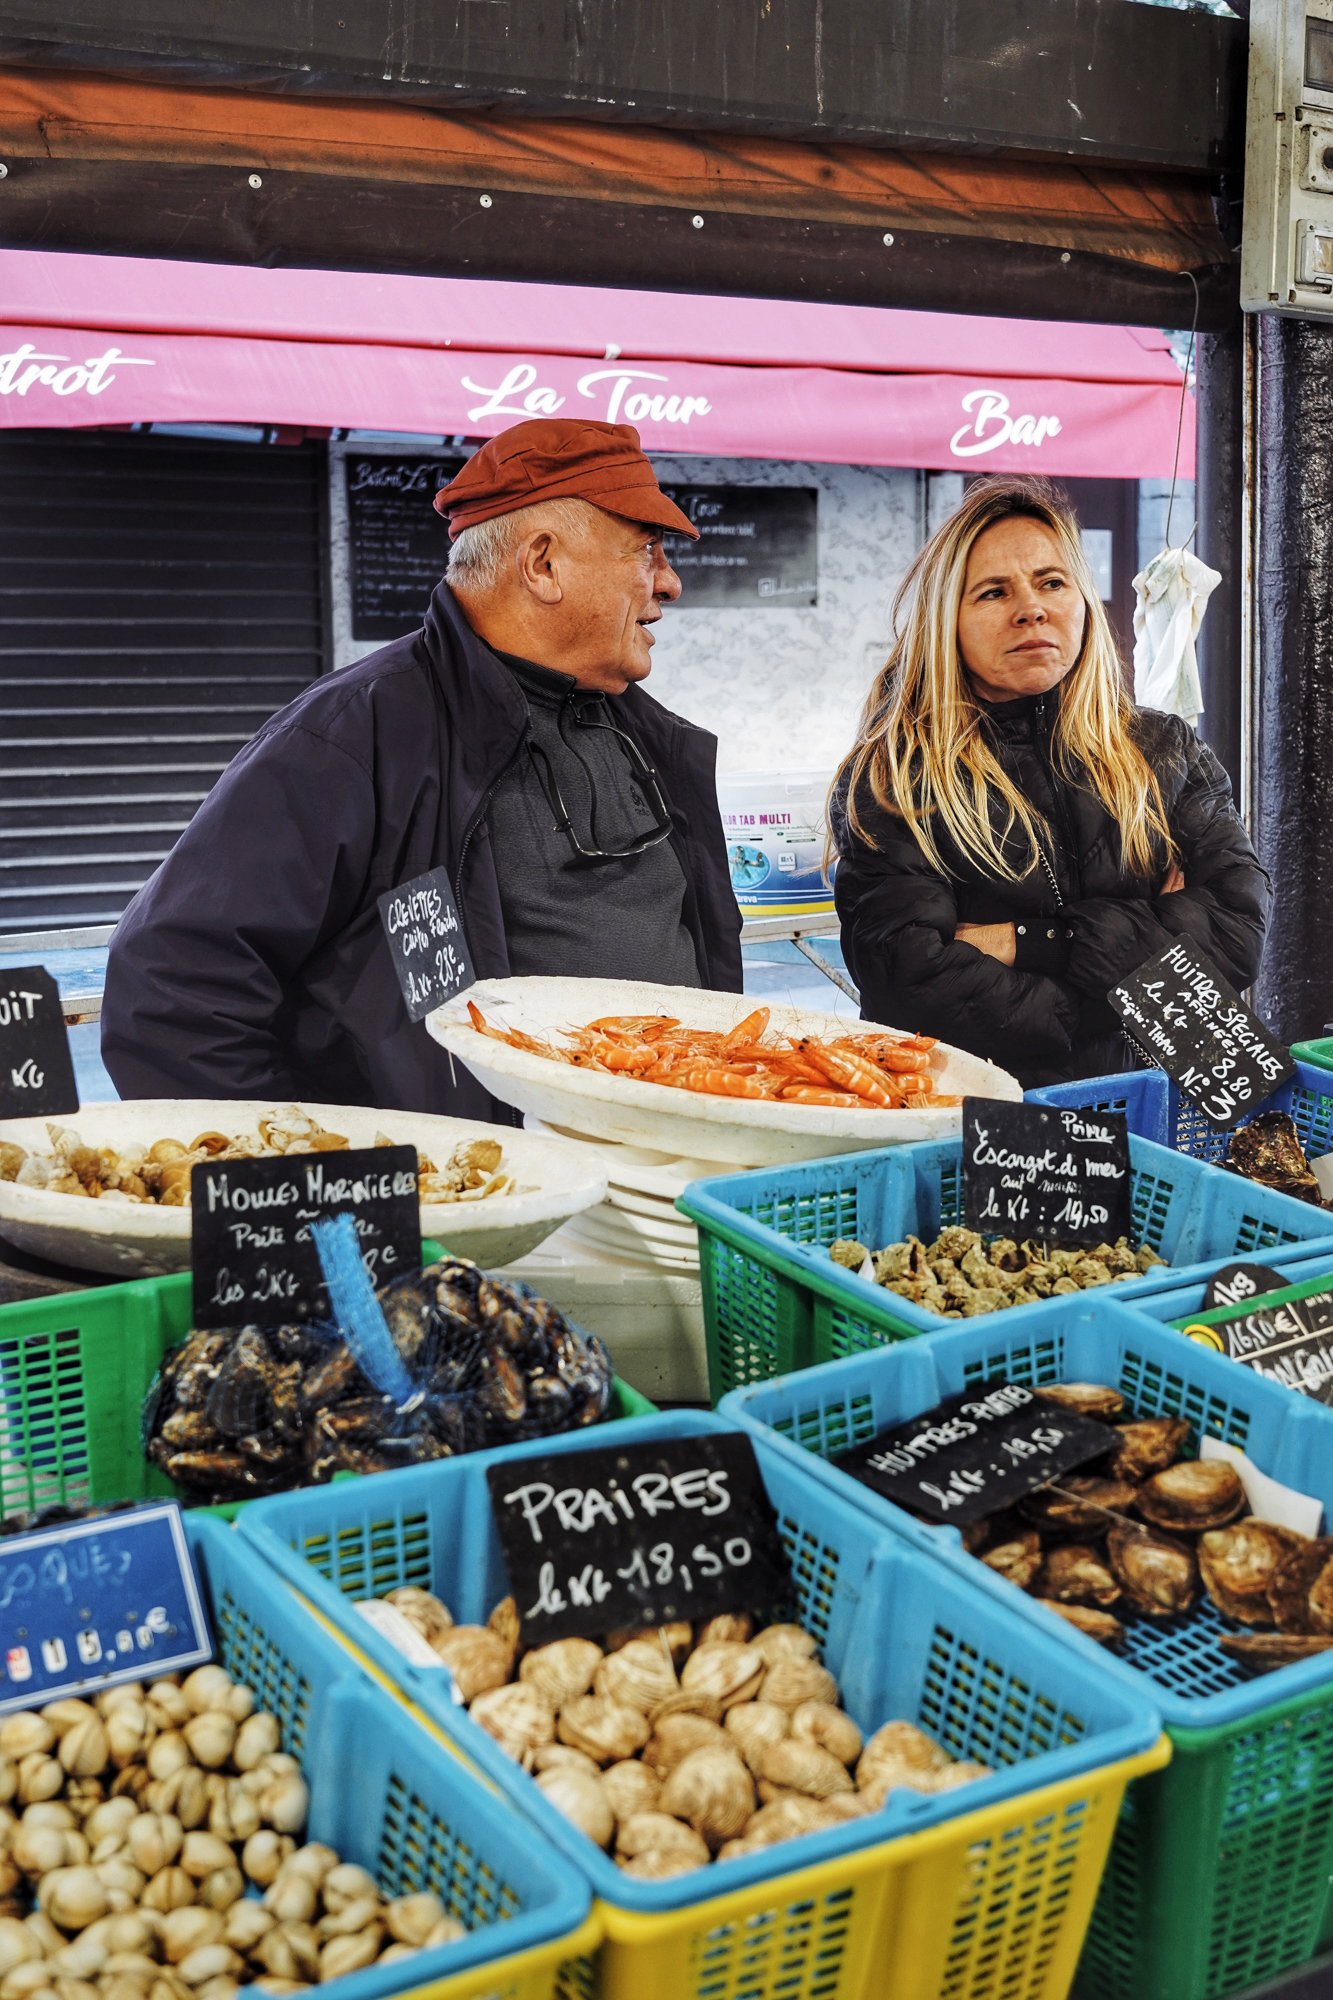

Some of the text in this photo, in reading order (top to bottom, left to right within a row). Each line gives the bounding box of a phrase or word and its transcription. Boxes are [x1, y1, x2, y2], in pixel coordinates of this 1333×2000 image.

[0, 343, 1063, 457] trot La Tour Bar
[739, 815, 755, 825] TAB
[759, 813, 791, 825] MULTI
[979, 1187, 1001, 1218] le
[1054, 1198, 1109, 1230] 19,50
